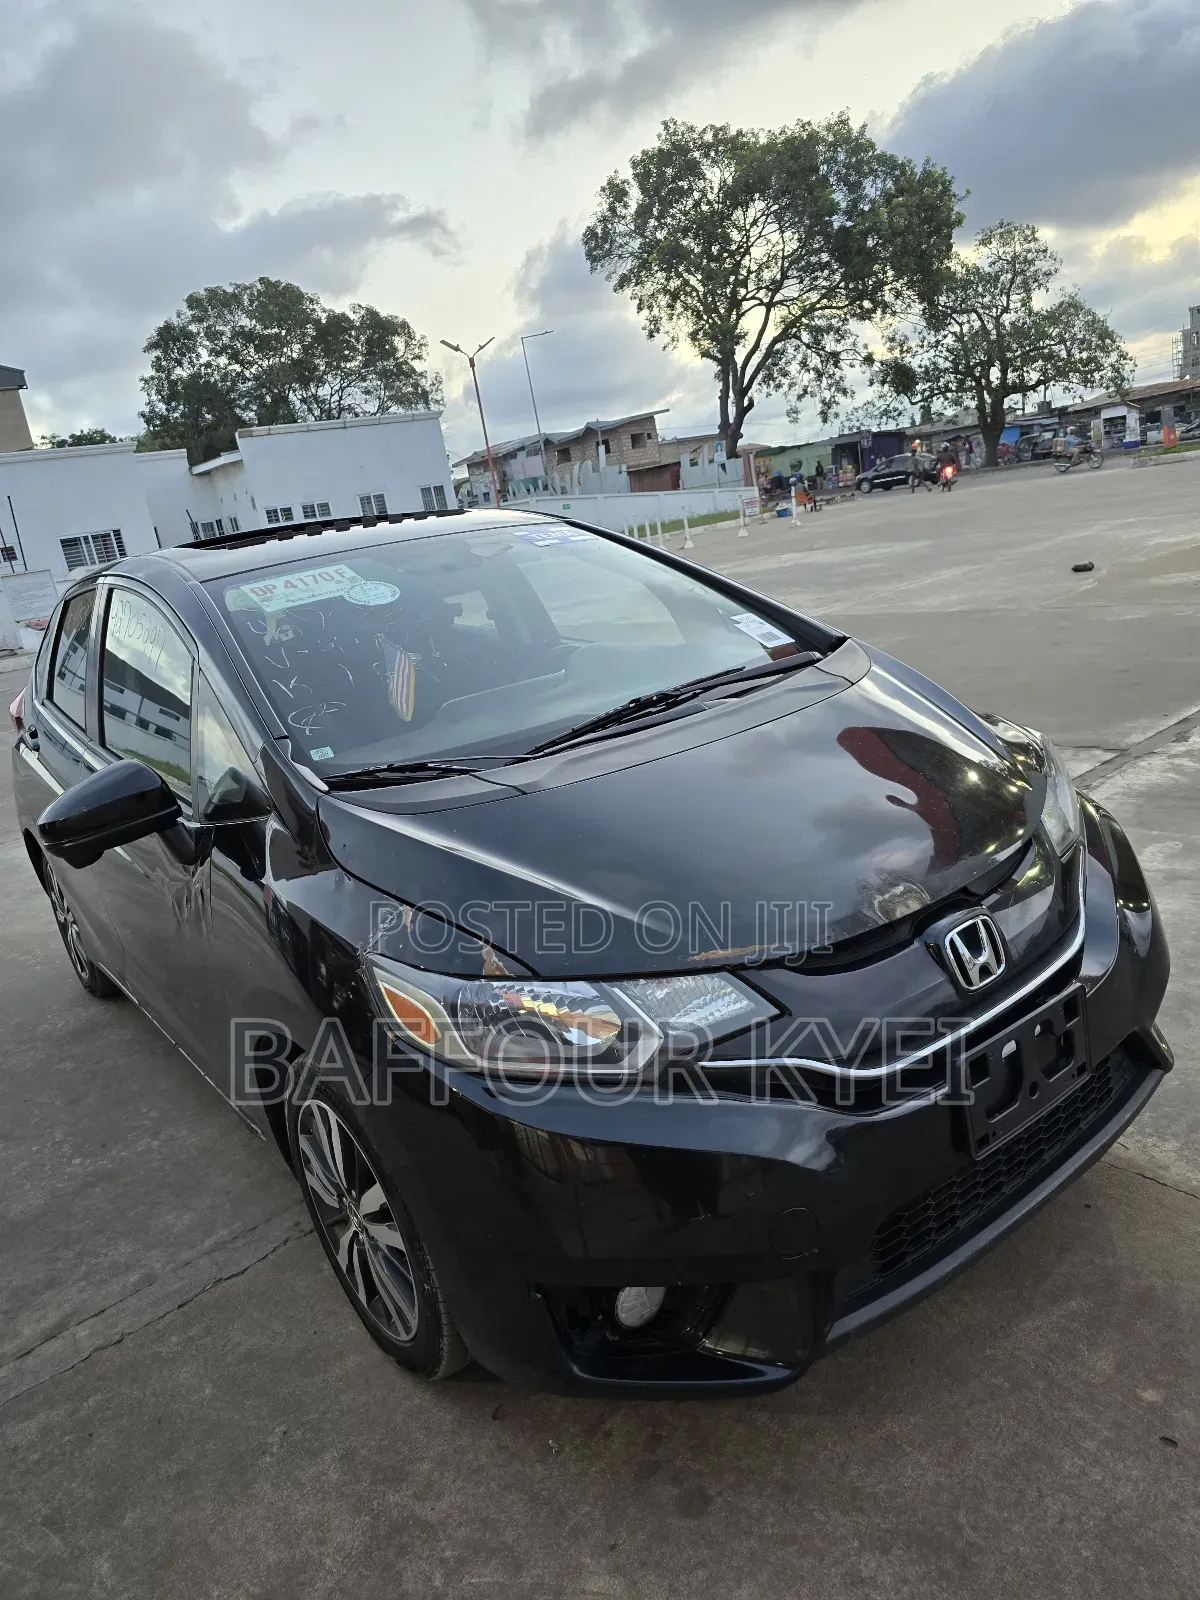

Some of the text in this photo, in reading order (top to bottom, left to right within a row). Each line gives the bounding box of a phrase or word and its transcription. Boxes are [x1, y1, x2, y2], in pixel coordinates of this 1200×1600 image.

[249, 584, 277, 597] DP
[283, 571, 335, 590] 4170
[332, 568, 347, 579] F
